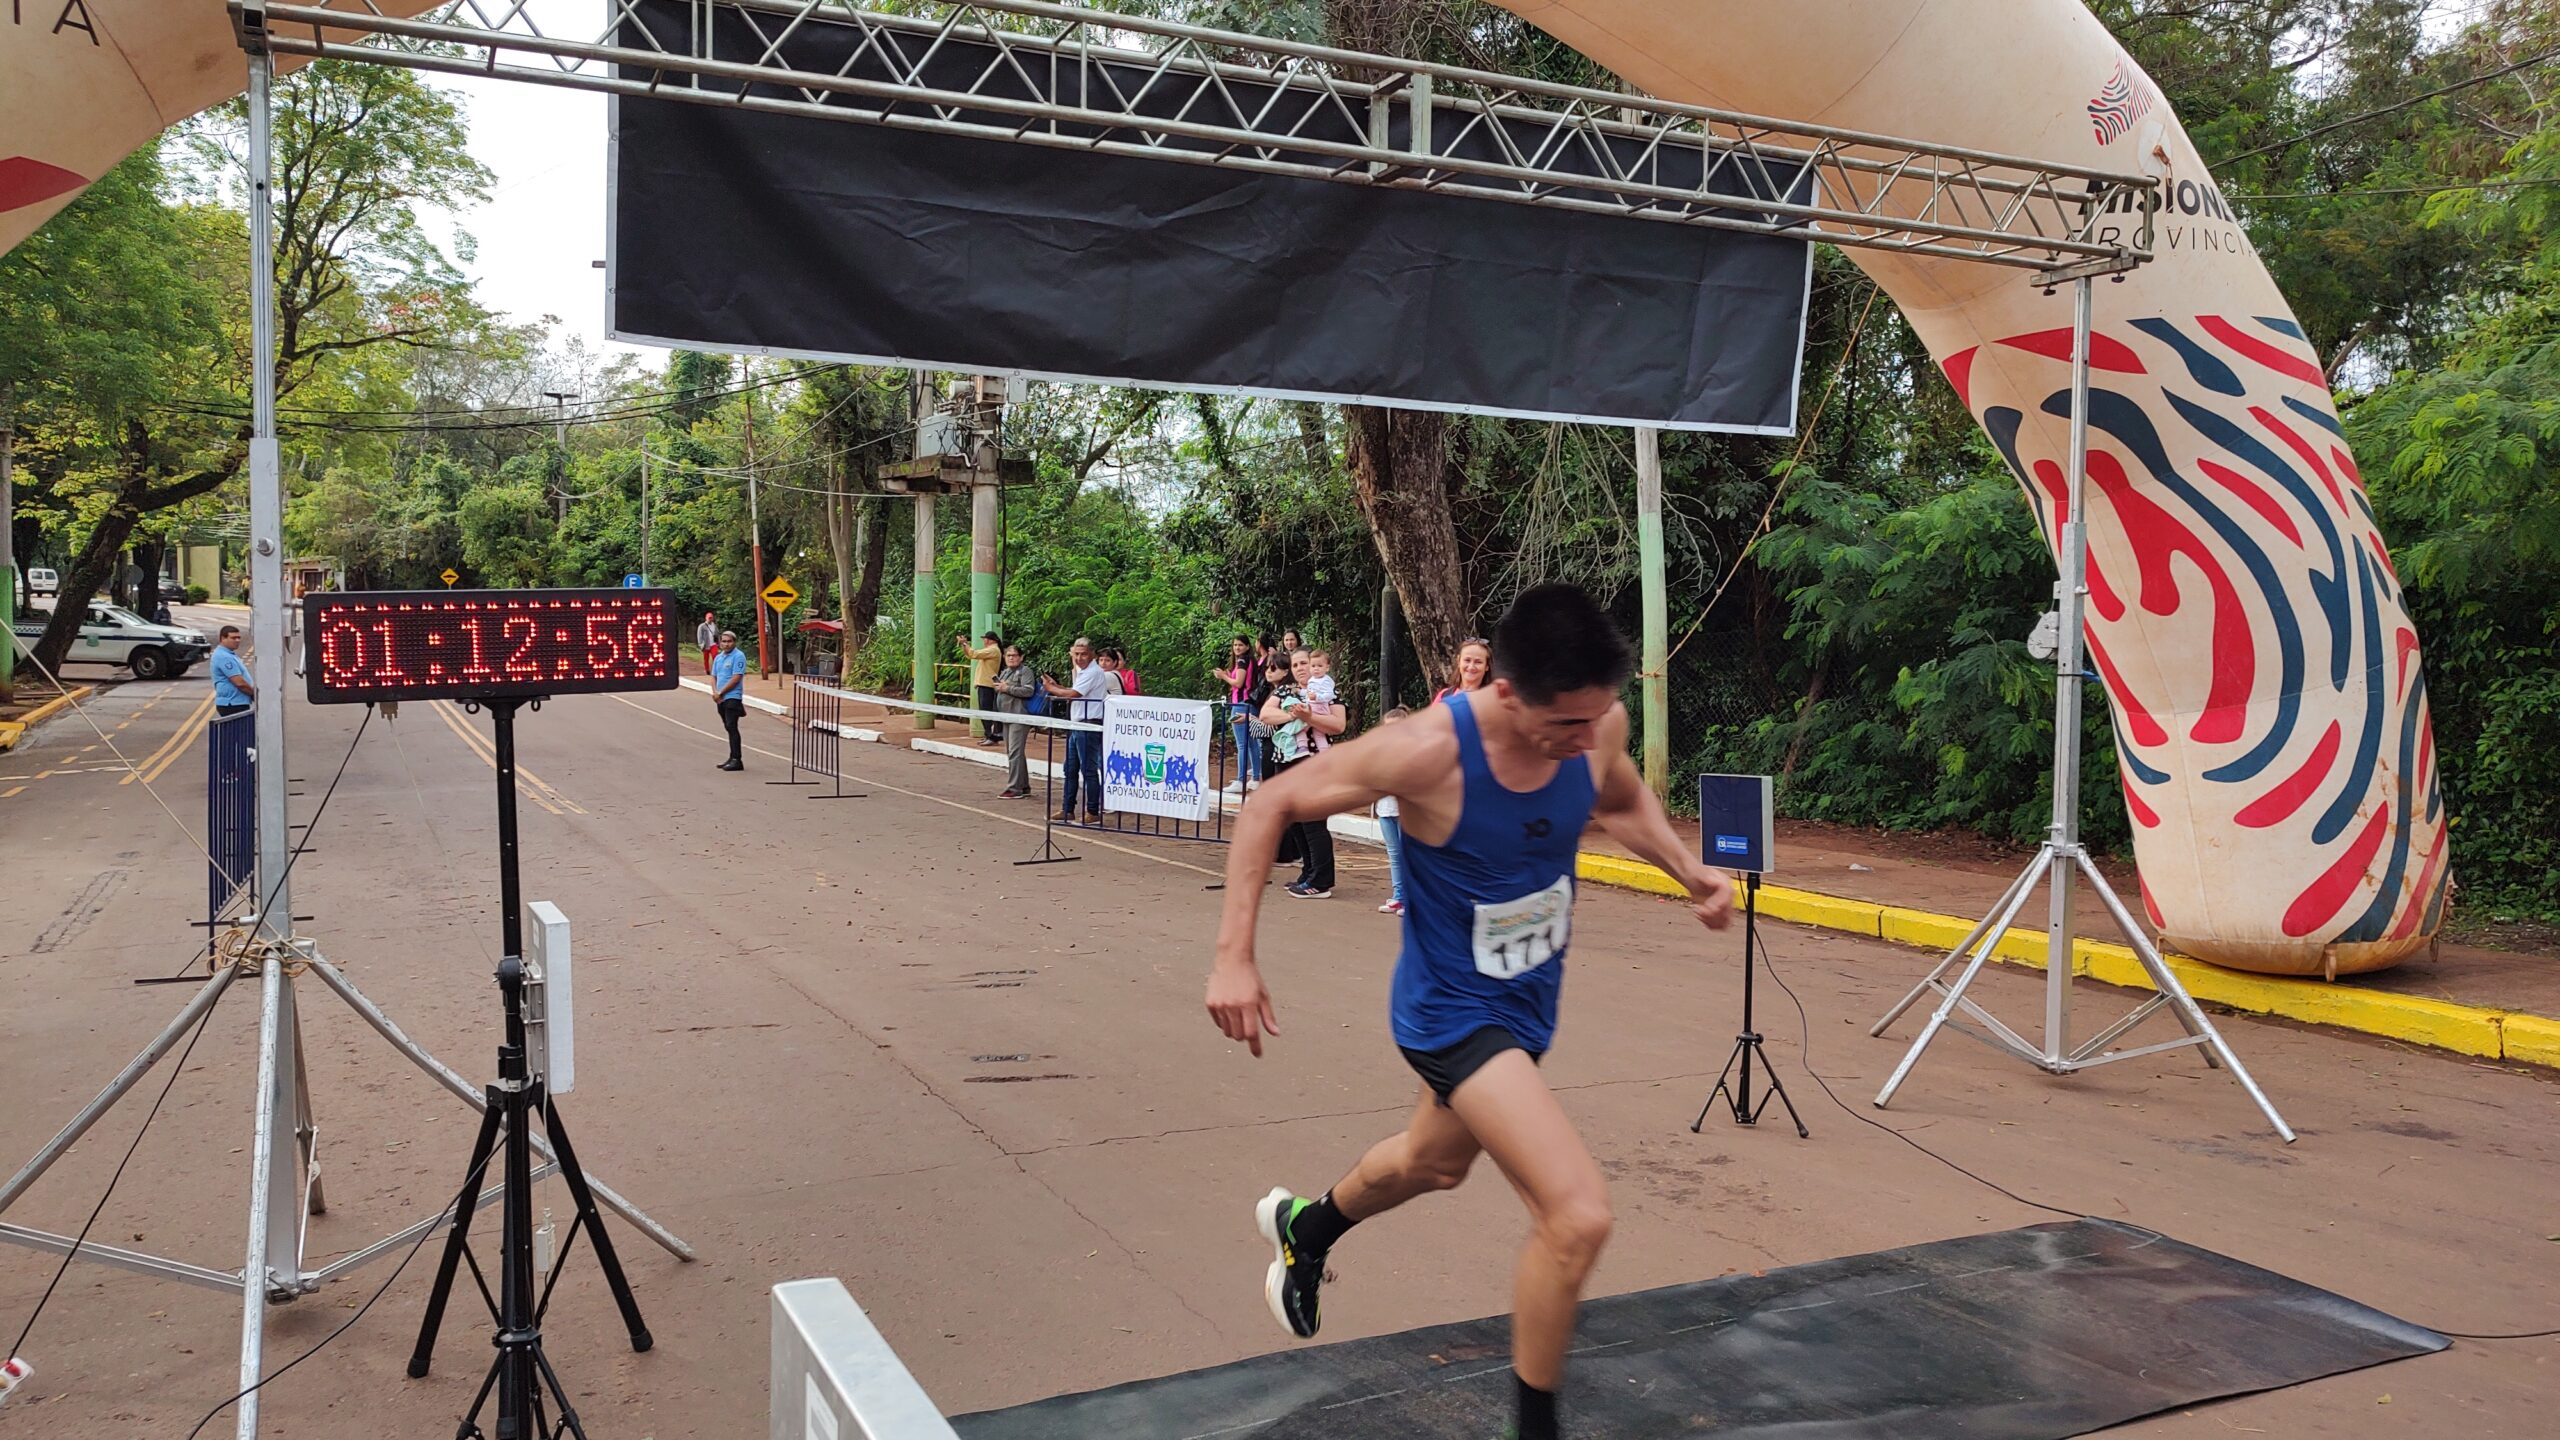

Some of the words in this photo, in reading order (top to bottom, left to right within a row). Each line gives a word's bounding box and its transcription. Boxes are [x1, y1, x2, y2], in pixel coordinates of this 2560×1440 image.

[629, 577, 637, 588] E
[322, 613, 664, 677] 01:12:56
[1116, 708, 1182, 722] MUNICIPALIDAD
[1184, 713, 1196, 724] DE
[1115, 723, 1153, 736] PUERTO
[1159, 726, 1196, 740] IGUAZÚ
[1106, 785, 1150, 799] APOYANDO
[1152, 790, 1160, 800] EL
[1162, 791, 1198, 805] DEPORTE
